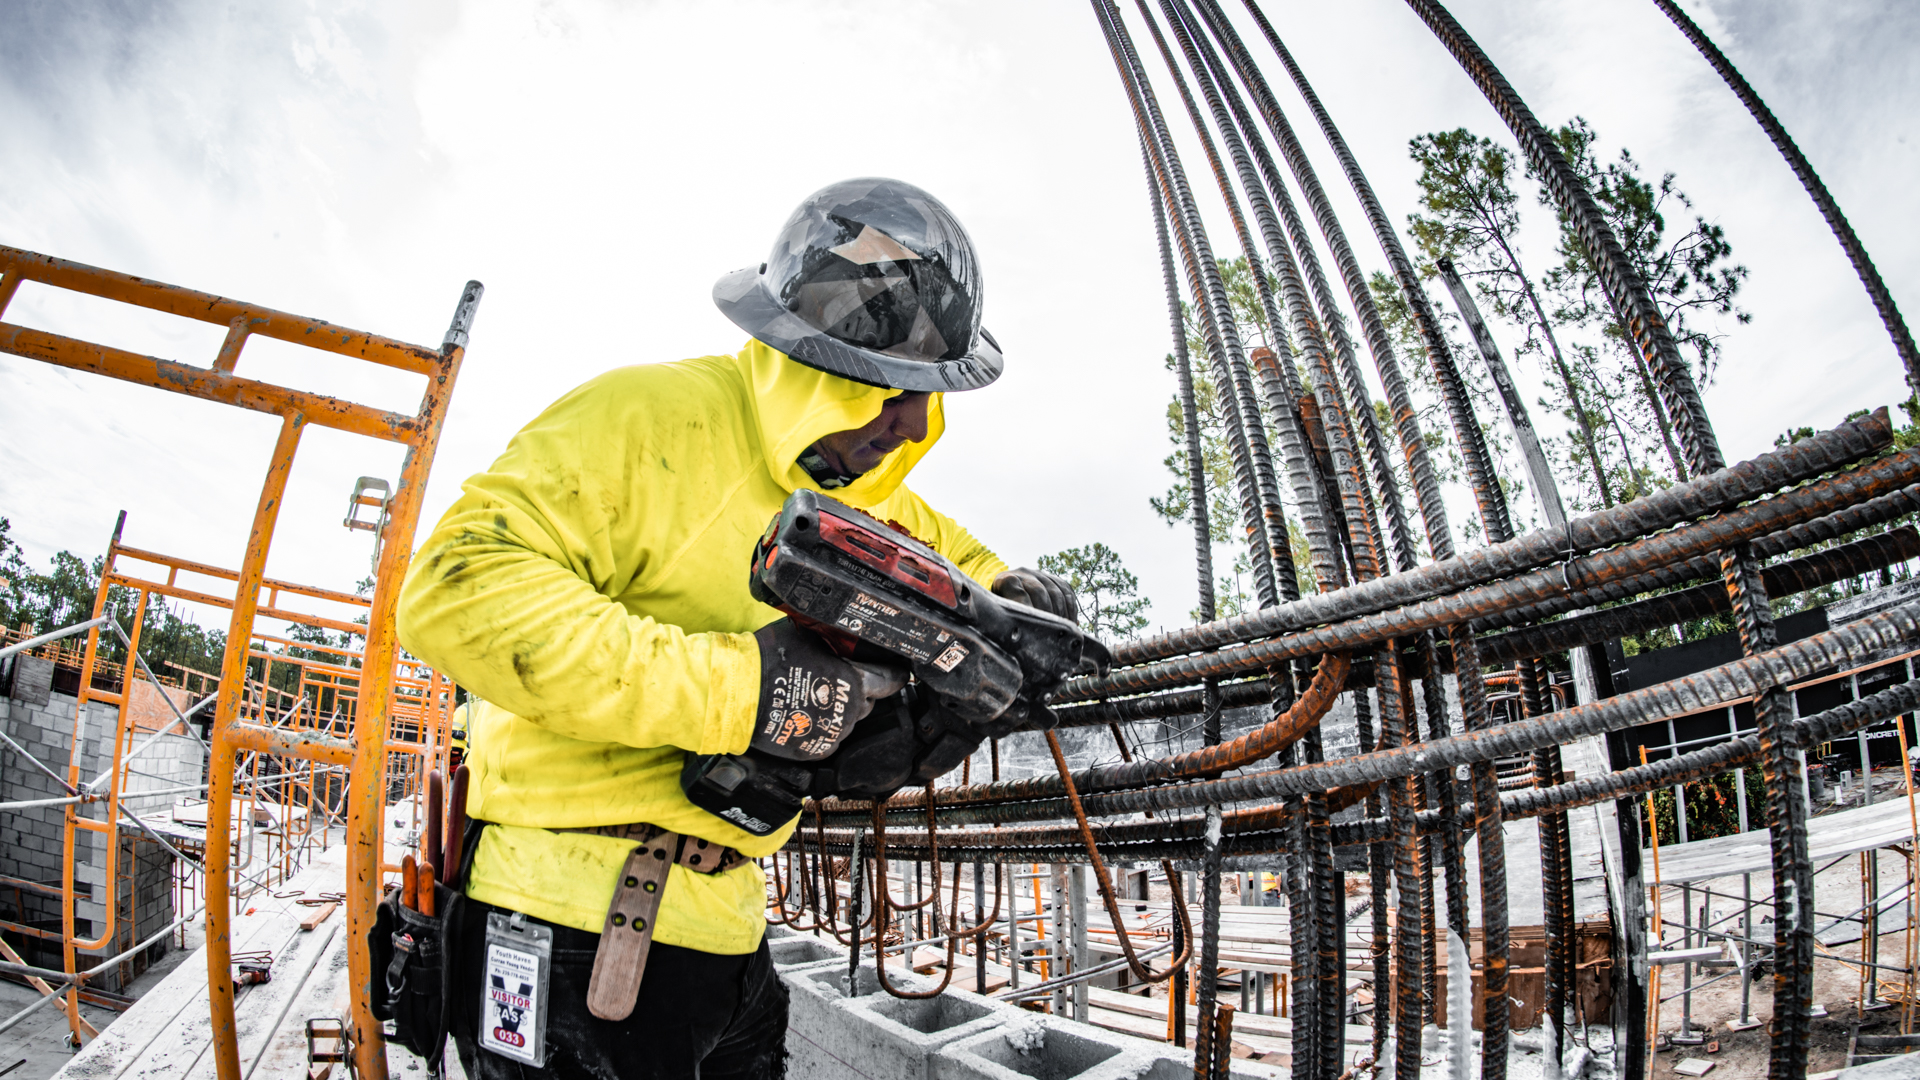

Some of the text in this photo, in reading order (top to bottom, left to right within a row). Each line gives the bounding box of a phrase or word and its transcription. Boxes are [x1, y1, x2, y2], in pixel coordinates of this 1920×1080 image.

[495, 949, 532, 964] Youth Haven
[519, 964, 535, 973] Vendor
[491, 989, 531, 1009] VISITOR
[493, 1004, 528, 1026] PASS
[498, 1029, 520, 1045] 033
